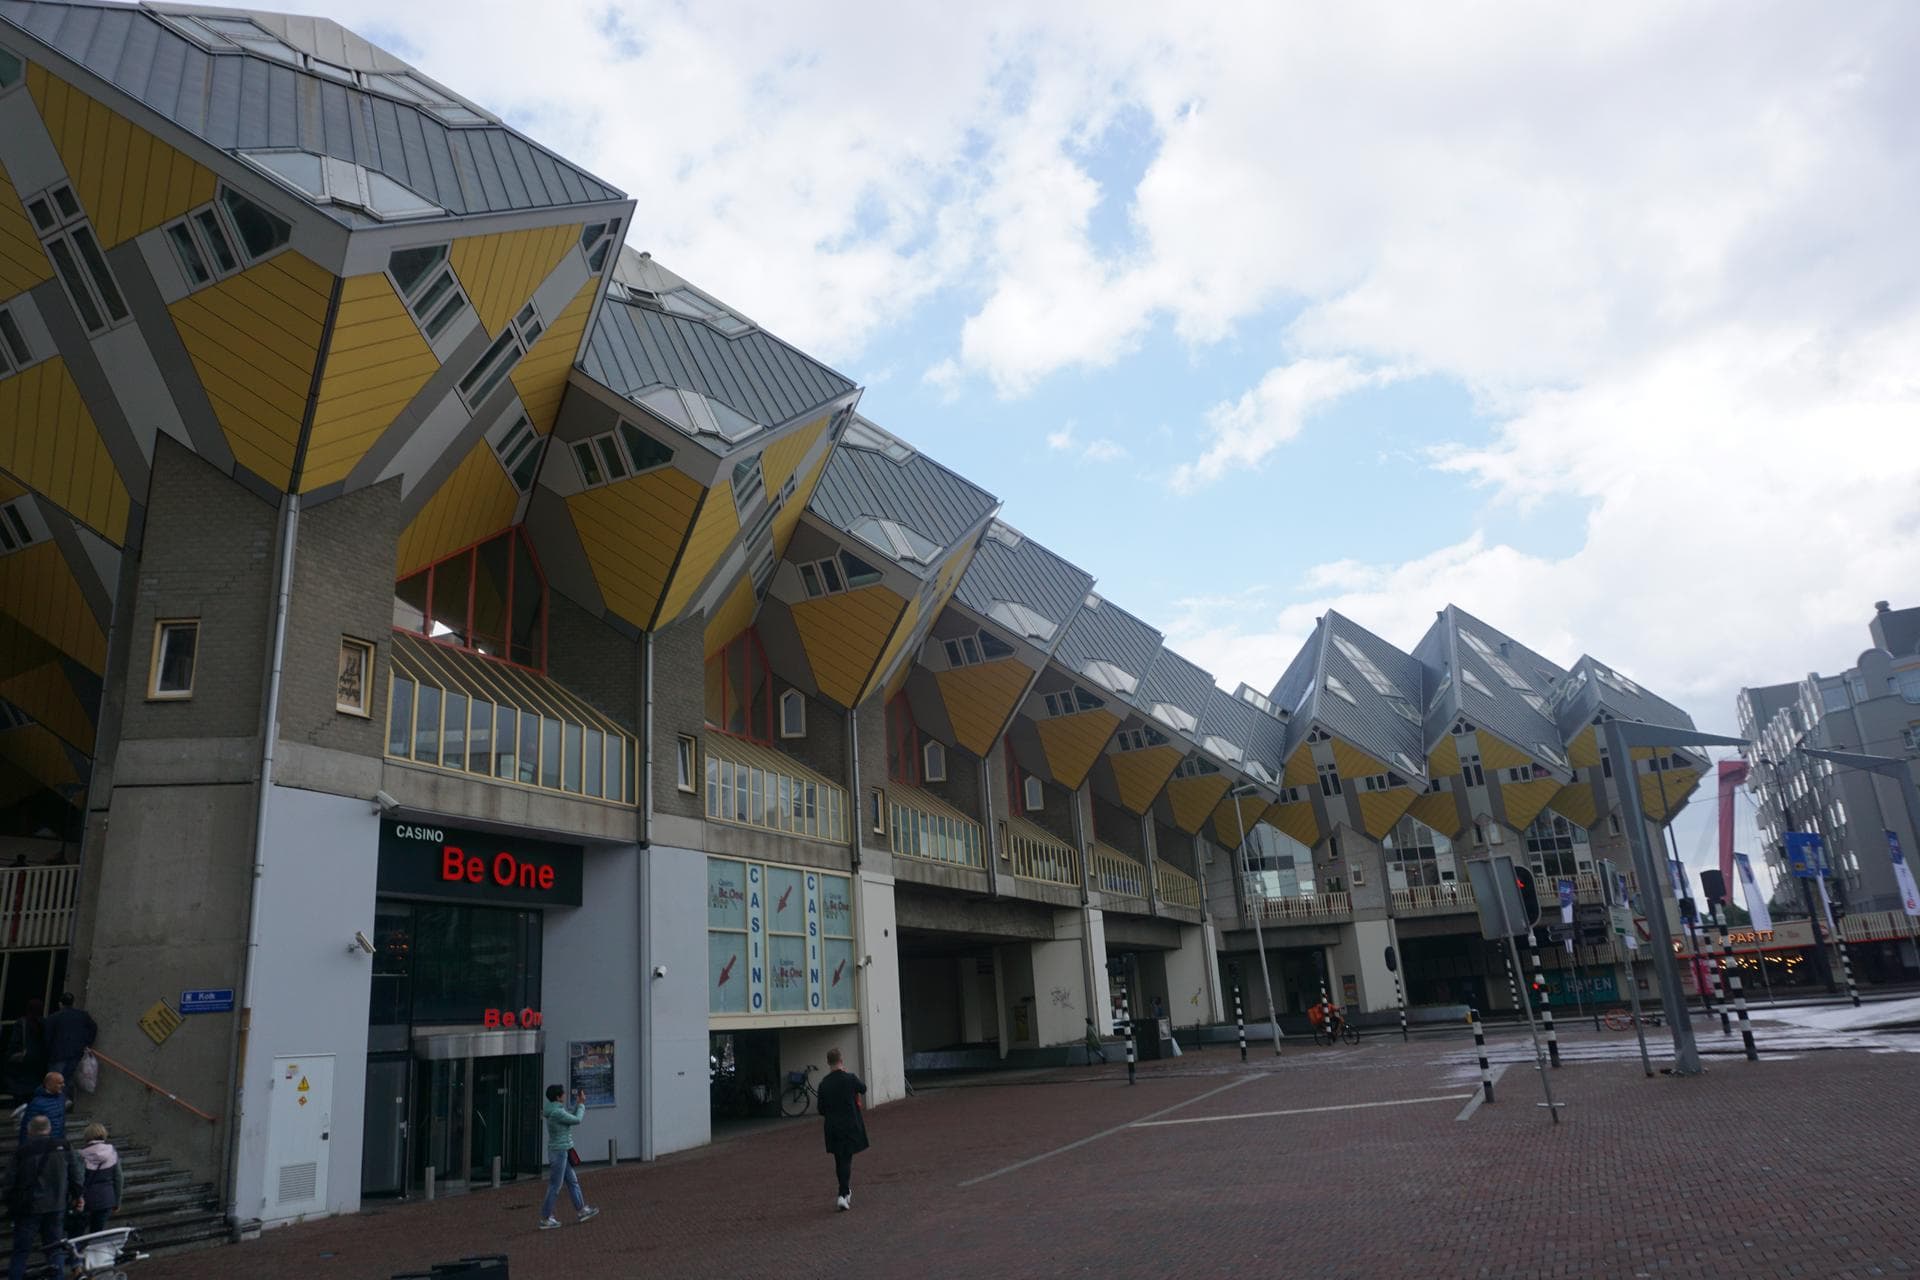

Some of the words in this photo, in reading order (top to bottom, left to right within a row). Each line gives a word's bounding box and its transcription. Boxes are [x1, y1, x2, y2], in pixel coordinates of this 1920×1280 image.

[396, 825, 444, 843] CASINO
[442, 846, 485, 883] Be
[493, 852, 555, 890] One
[750, 868, 763, 1009] CASINO
[807, 876, 820, 1007] CASINO
[484, 1008, 516, 1028] Be
